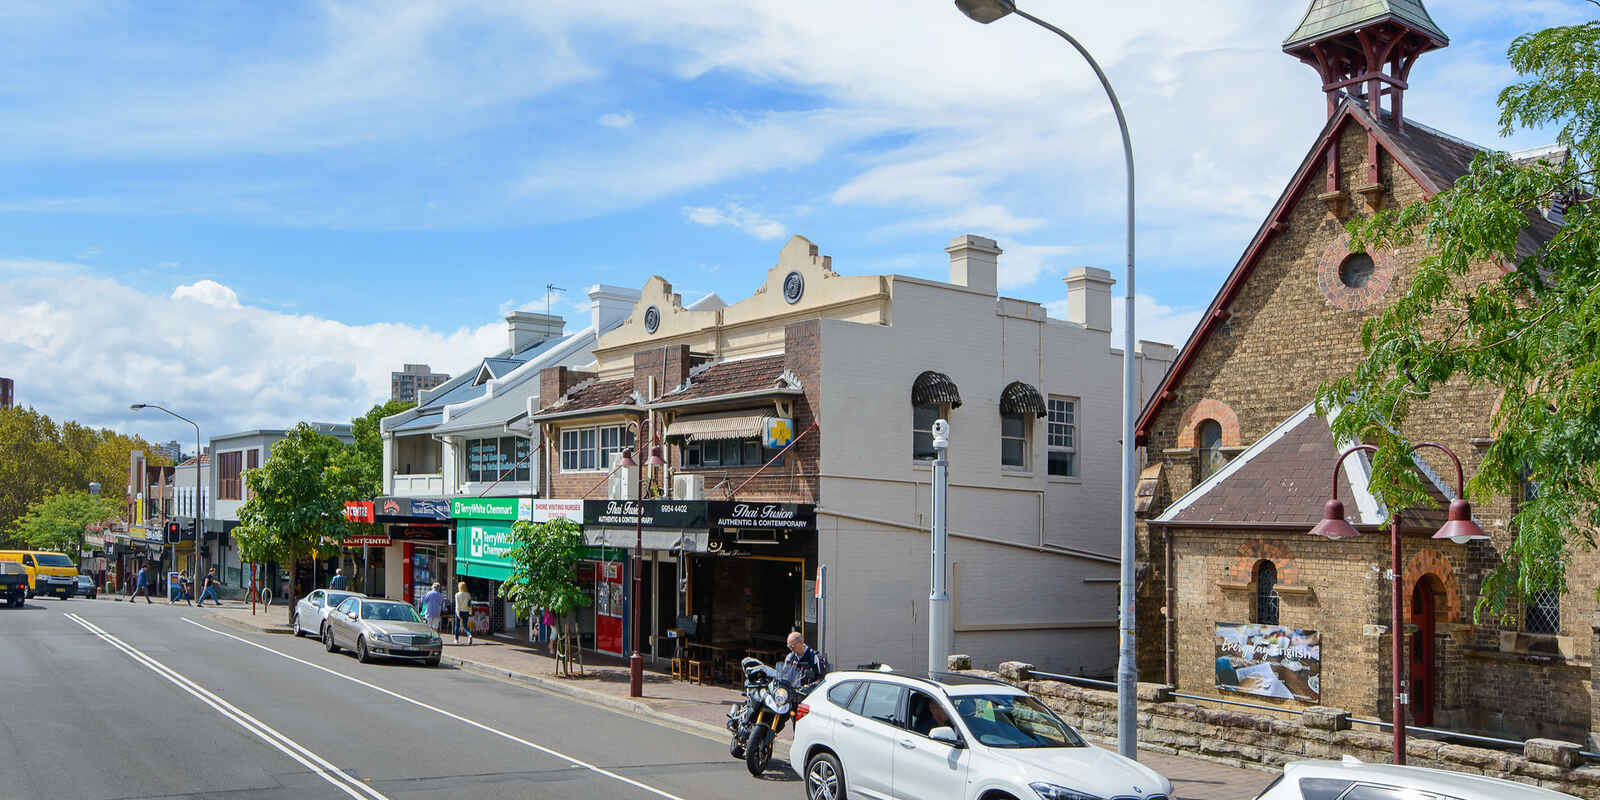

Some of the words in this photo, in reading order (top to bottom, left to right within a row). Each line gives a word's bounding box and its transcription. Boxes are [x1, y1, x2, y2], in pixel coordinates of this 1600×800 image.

[461, 503, 486, 516] TerryWhite
[486, 503, 513, 515] Chemmart
[606, 501, 622, 515] Thai
[622, 501, 645, 515] Fusin
[731, 503, 759, 519] Thai
[760, 505, 794, 519] Fusion
[717, 518, 752, 527] AUTHENTIC
[752, 519, 758, 527] &
[758, 519, 808, 528] CONTEMPORARY
[1221, 639, 1271, 661] Everyday
